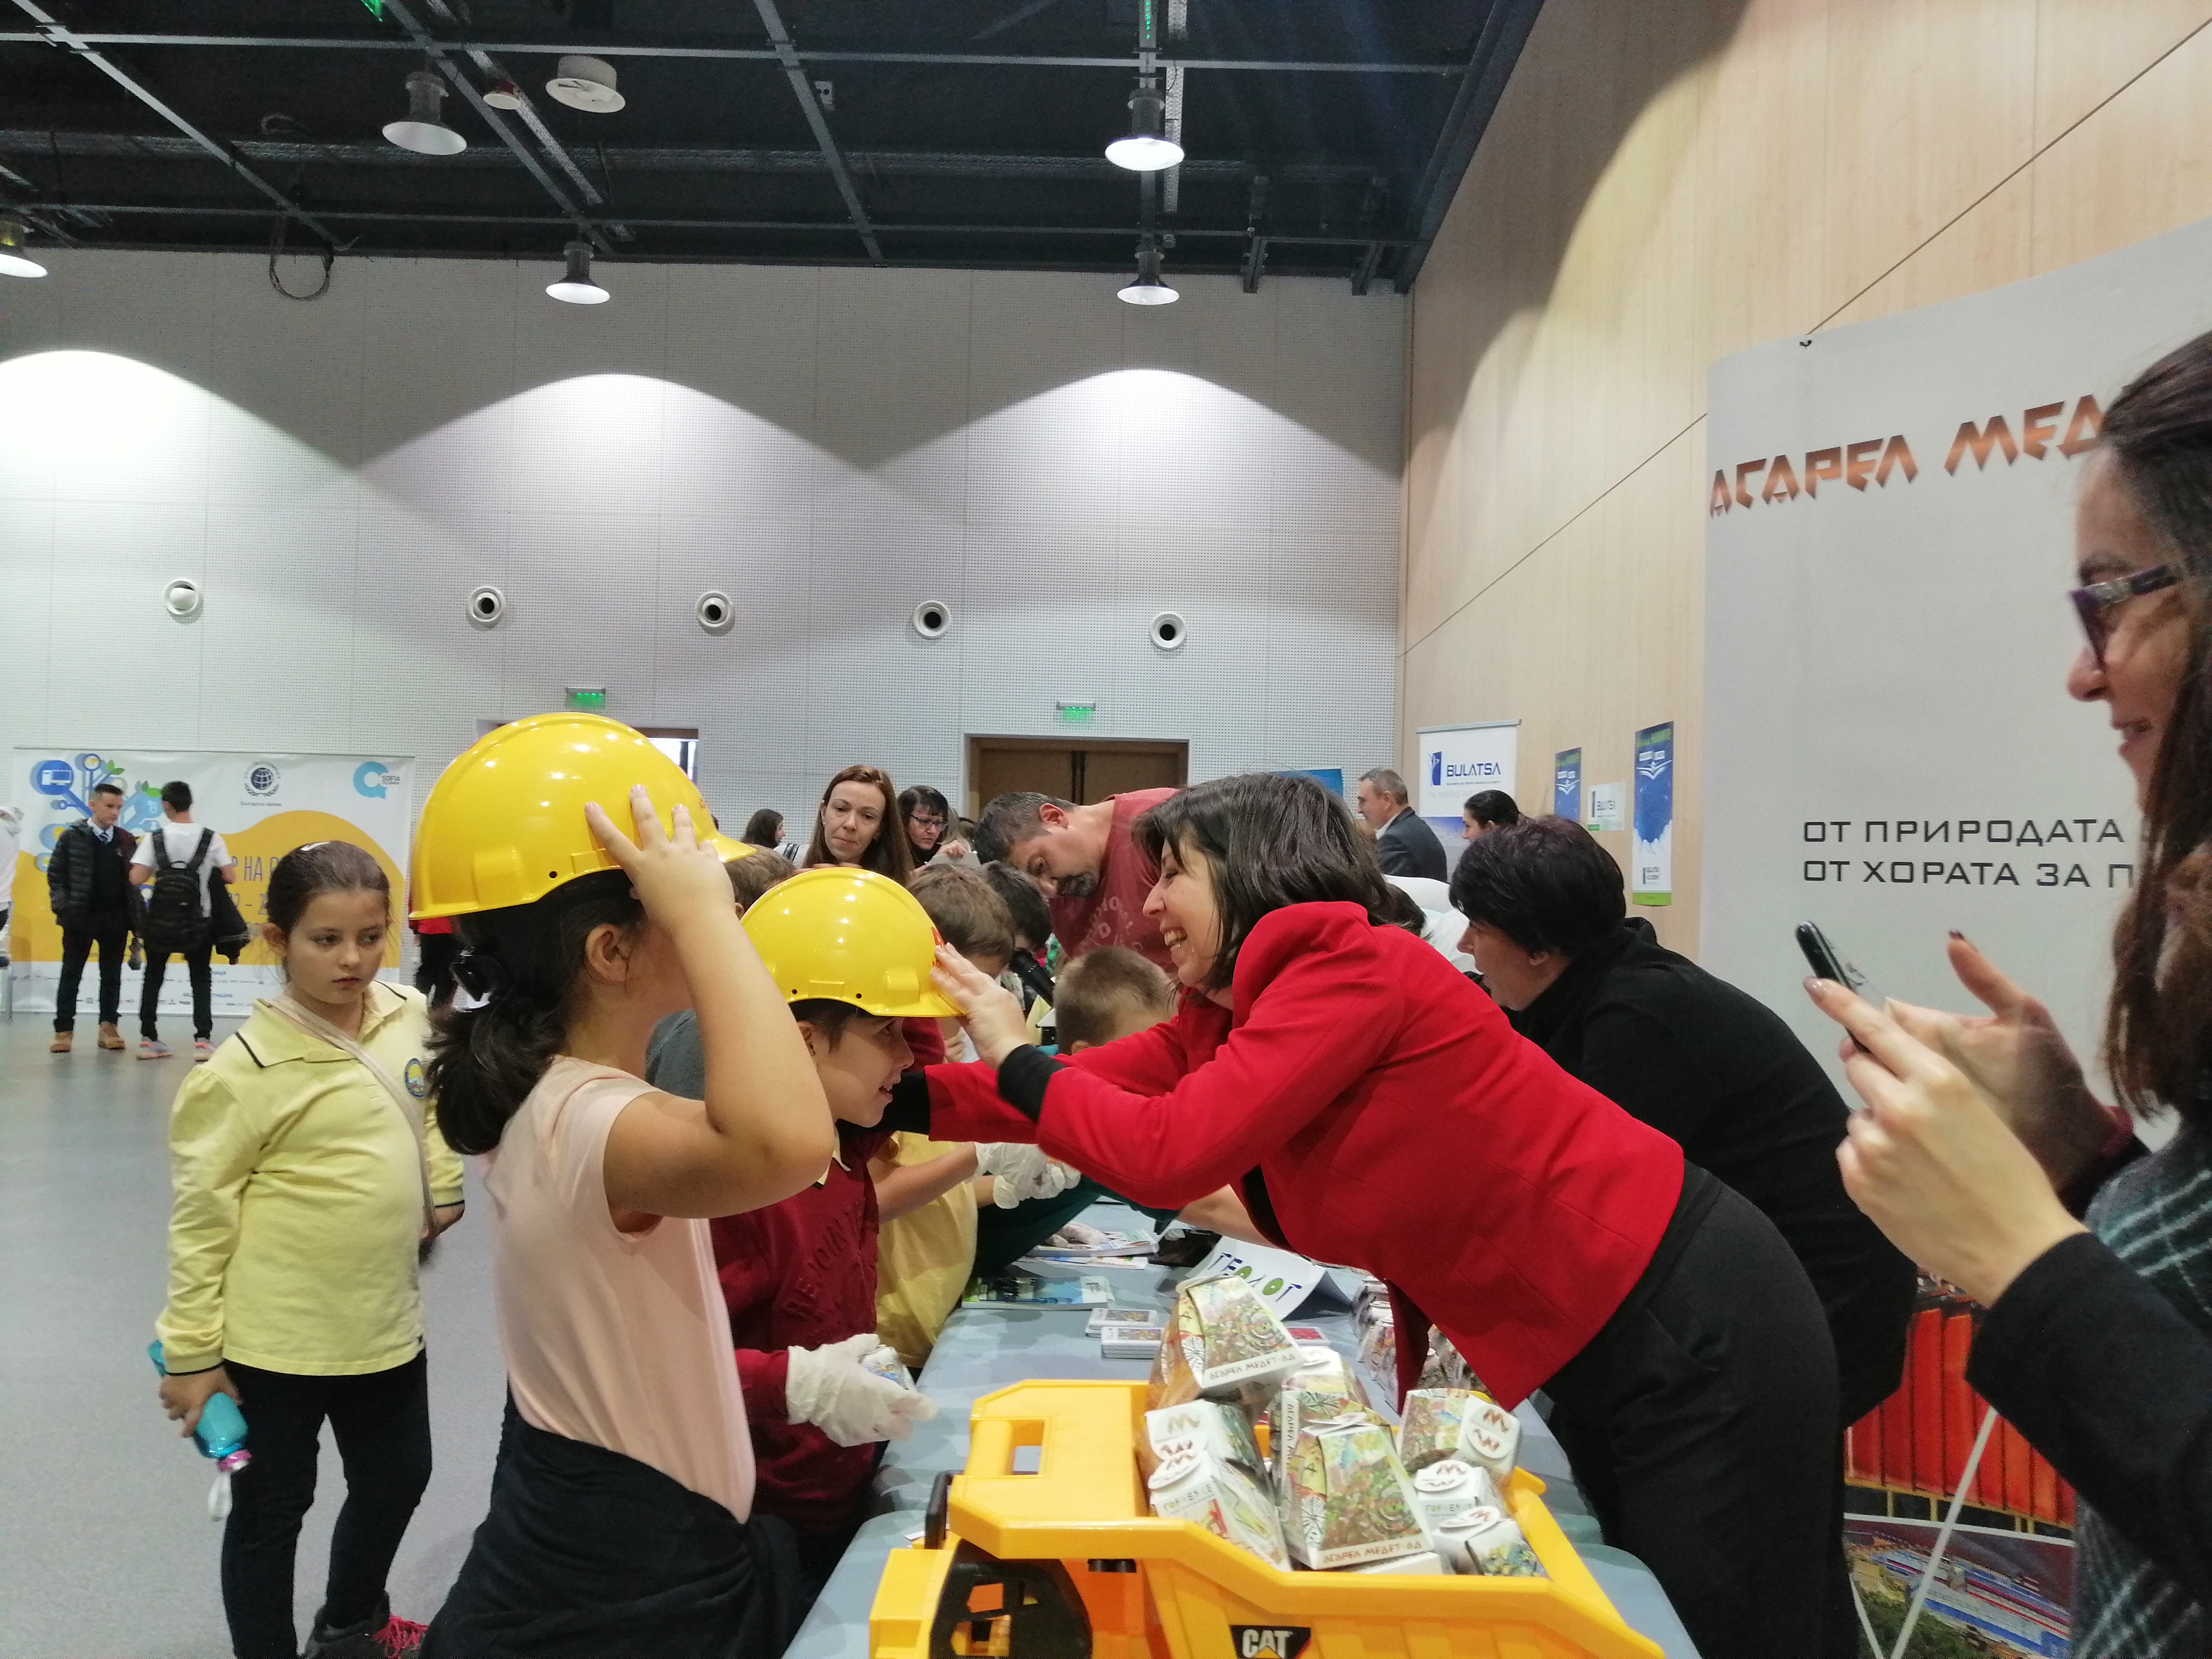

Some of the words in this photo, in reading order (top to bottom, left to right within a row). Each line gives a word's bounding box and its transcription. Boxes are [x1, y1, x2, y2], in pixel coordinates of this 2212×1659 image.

[1944, 386, 2119, 477] МЕД
[1447, 762, 1501, 777] BULATSA
[1804, 821, 1851, 842] ОТ
[1866, 819, 2125, 847] ПРИРОДАТА
[243, 856, 263, 881] НА
[1804, 860, 1850, 881] ОТ
[1862, 861, 2021, 886] ХОРАТА
[2037, 863, 2091, 887] ЗА
[1242, 1629, 1290, 1658] CAT
